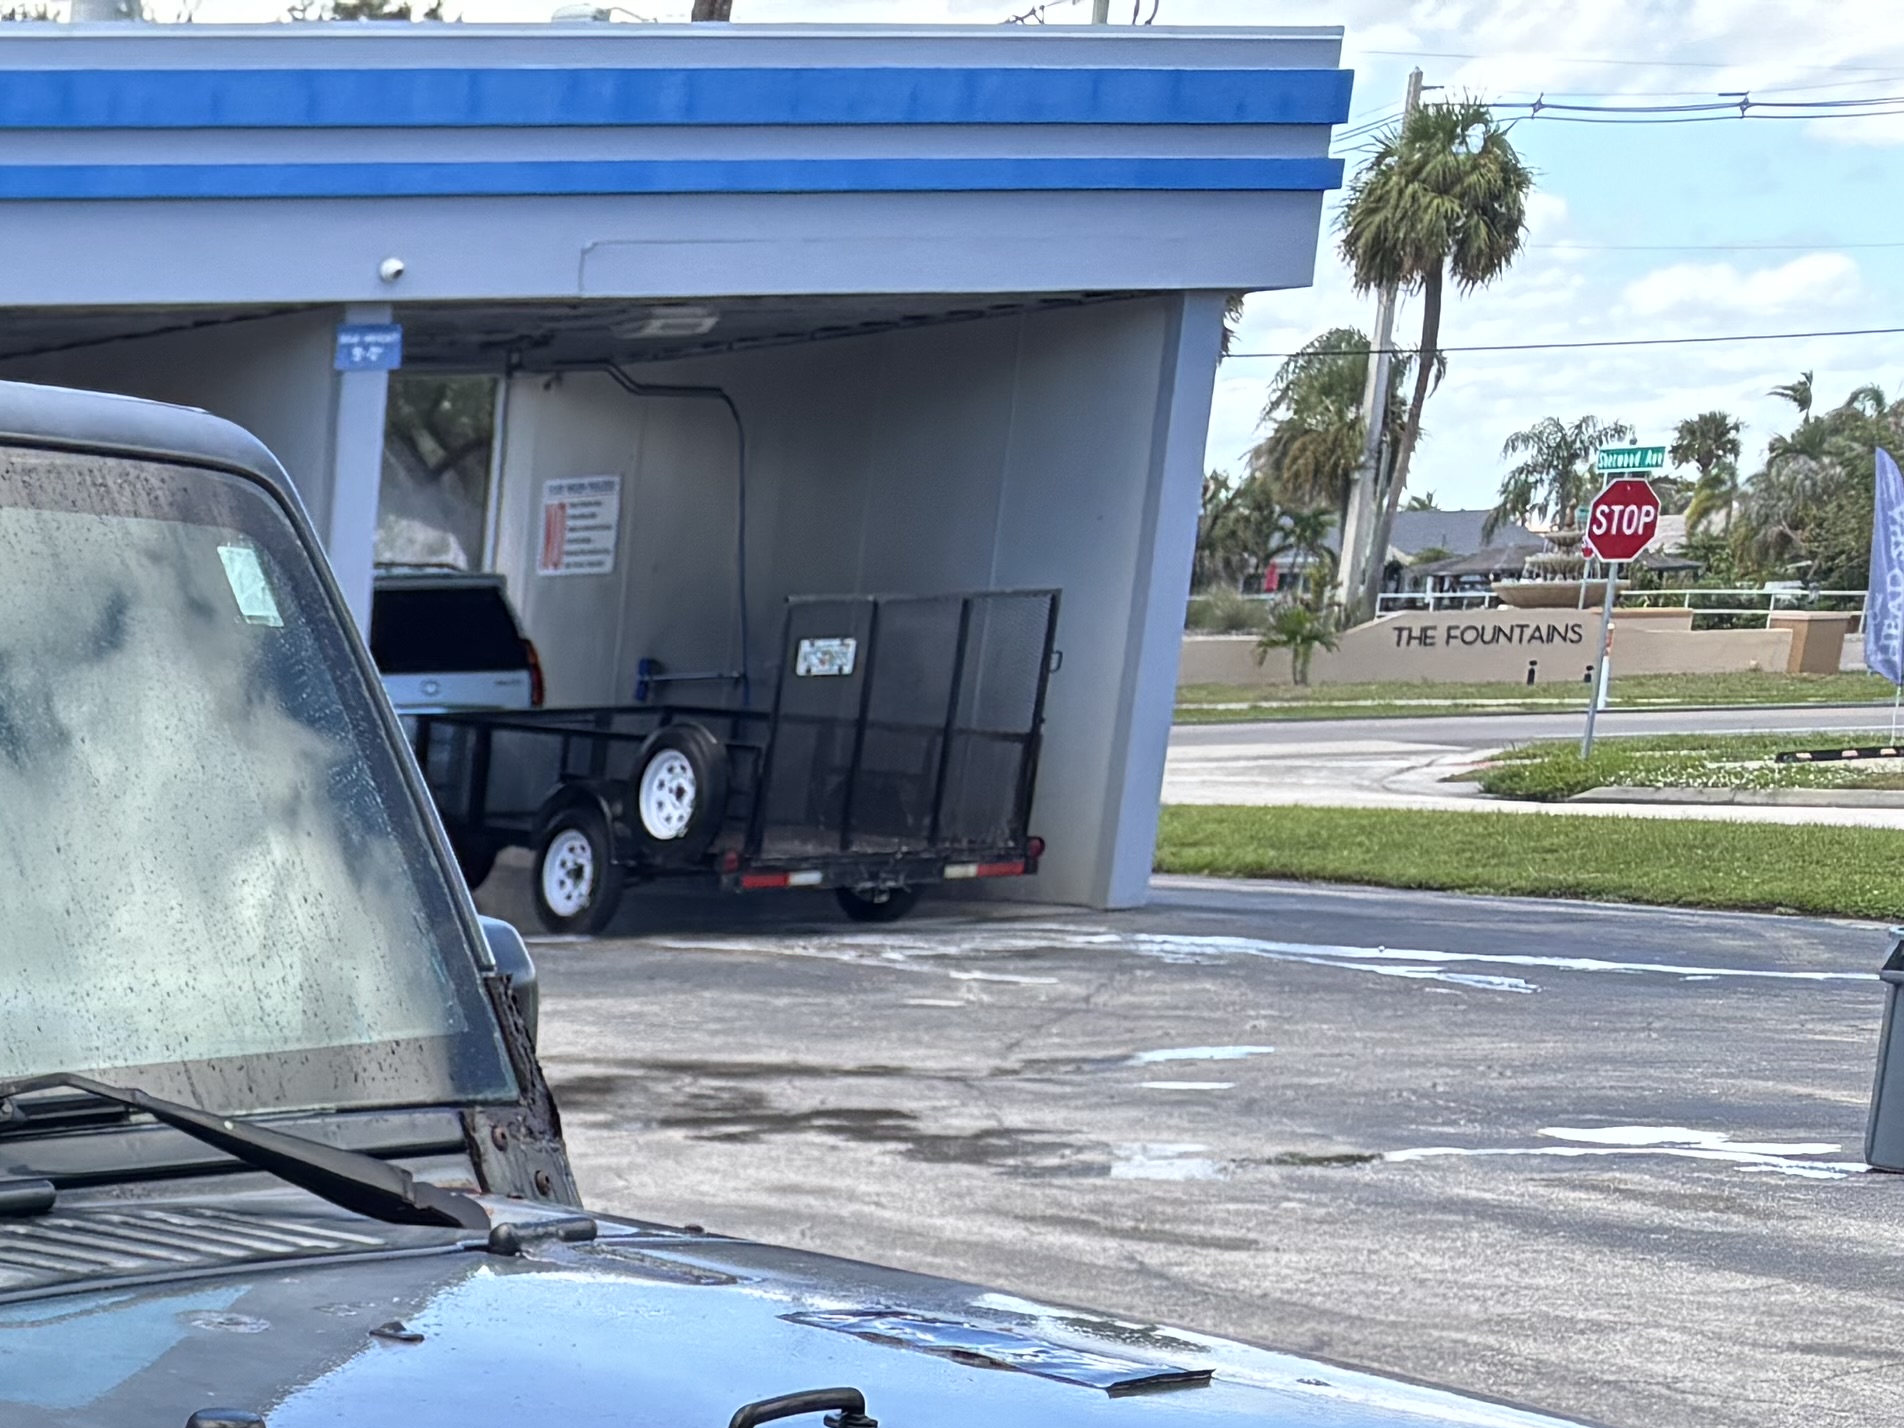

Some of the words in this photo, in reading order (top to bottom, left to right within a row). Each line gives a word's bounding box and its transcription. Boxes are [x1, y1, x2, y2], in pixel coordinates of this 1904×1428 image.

[1592, 504, 1656, 536] STOP
[1393, 625, 1437, 647] THE
[1445, 623, 1583, 647] FOUNTAINS
